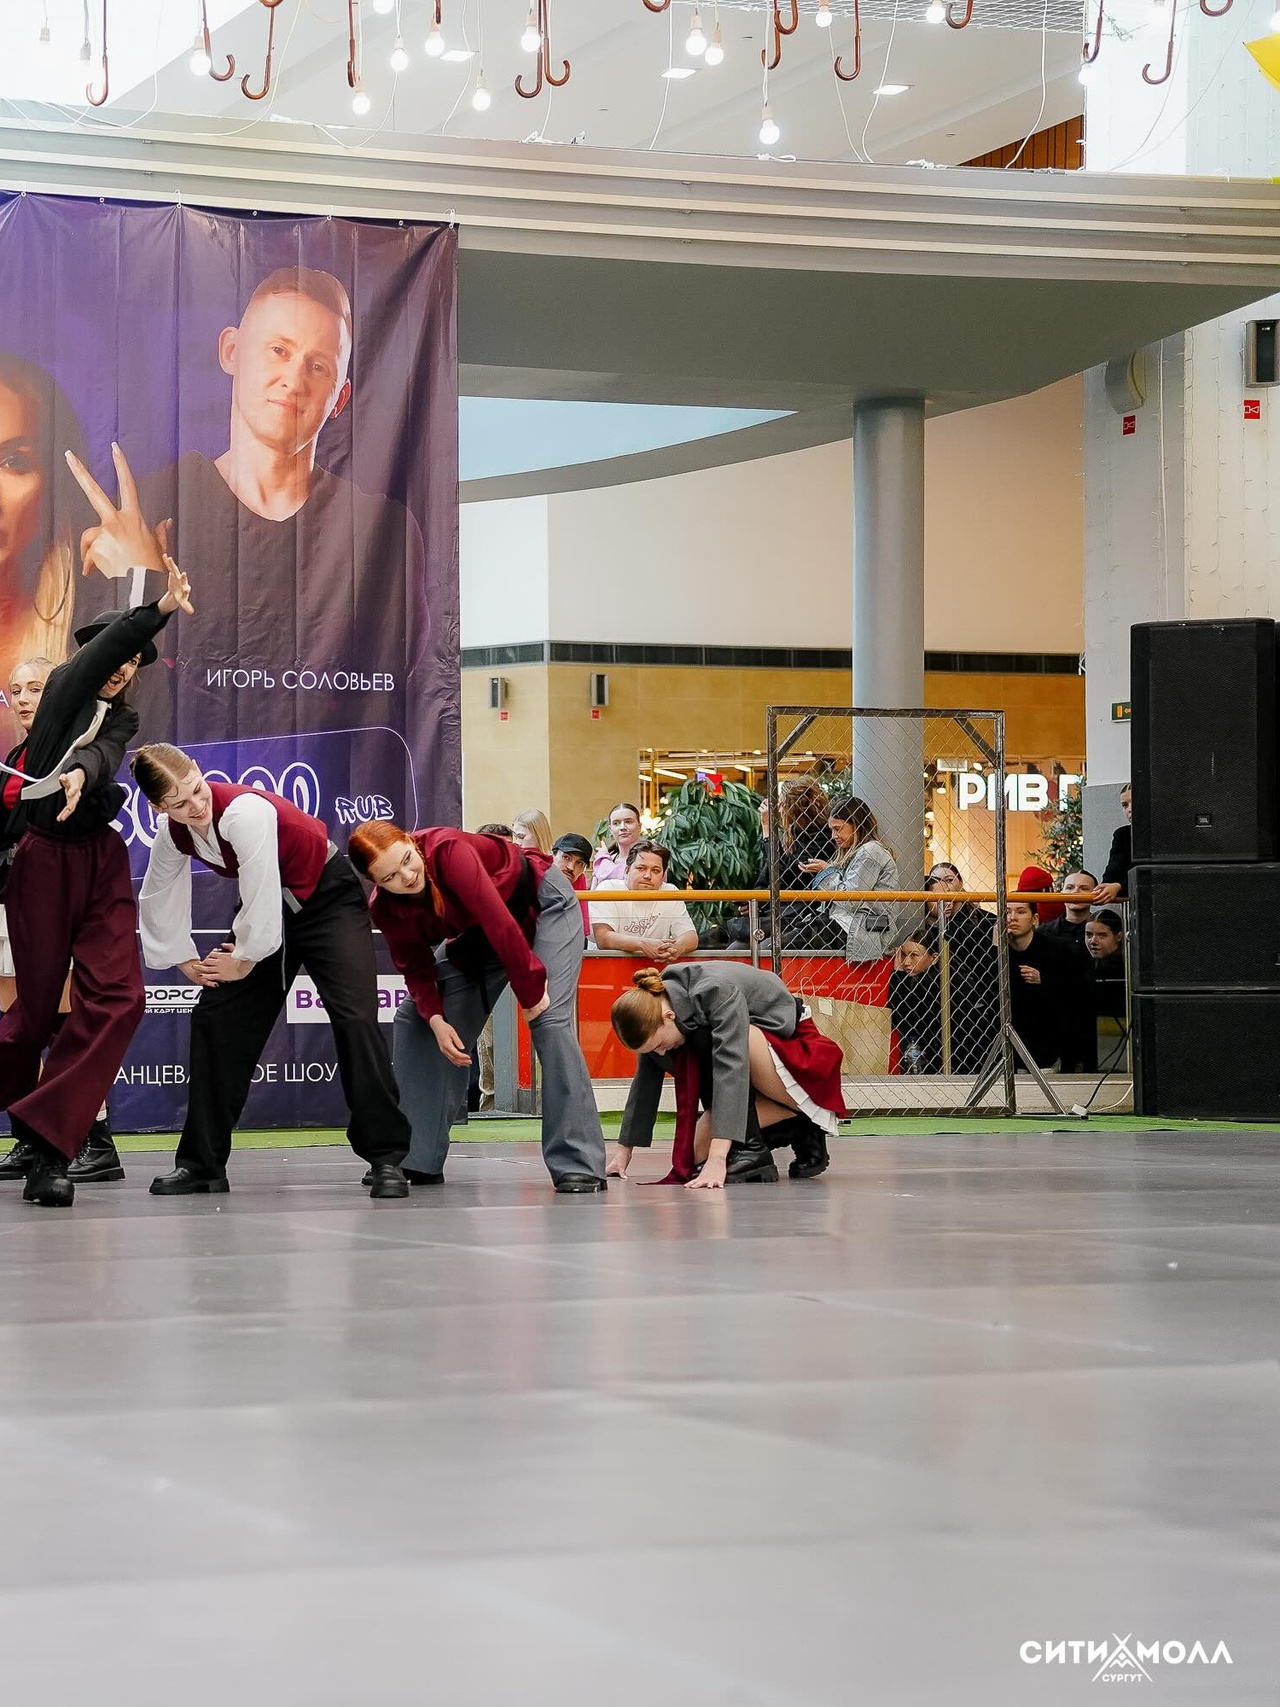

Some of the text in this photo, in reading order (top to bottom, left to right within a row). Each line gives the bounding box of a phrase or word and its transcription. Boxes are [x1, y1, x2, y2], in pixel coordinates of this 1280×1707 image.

[206, 669, 395, 692] ИГОРЬ СОЛОВЬЕВ
[335, 794, 395, 825] RUB
[284, 1062, 338, 1083] ШОУ
